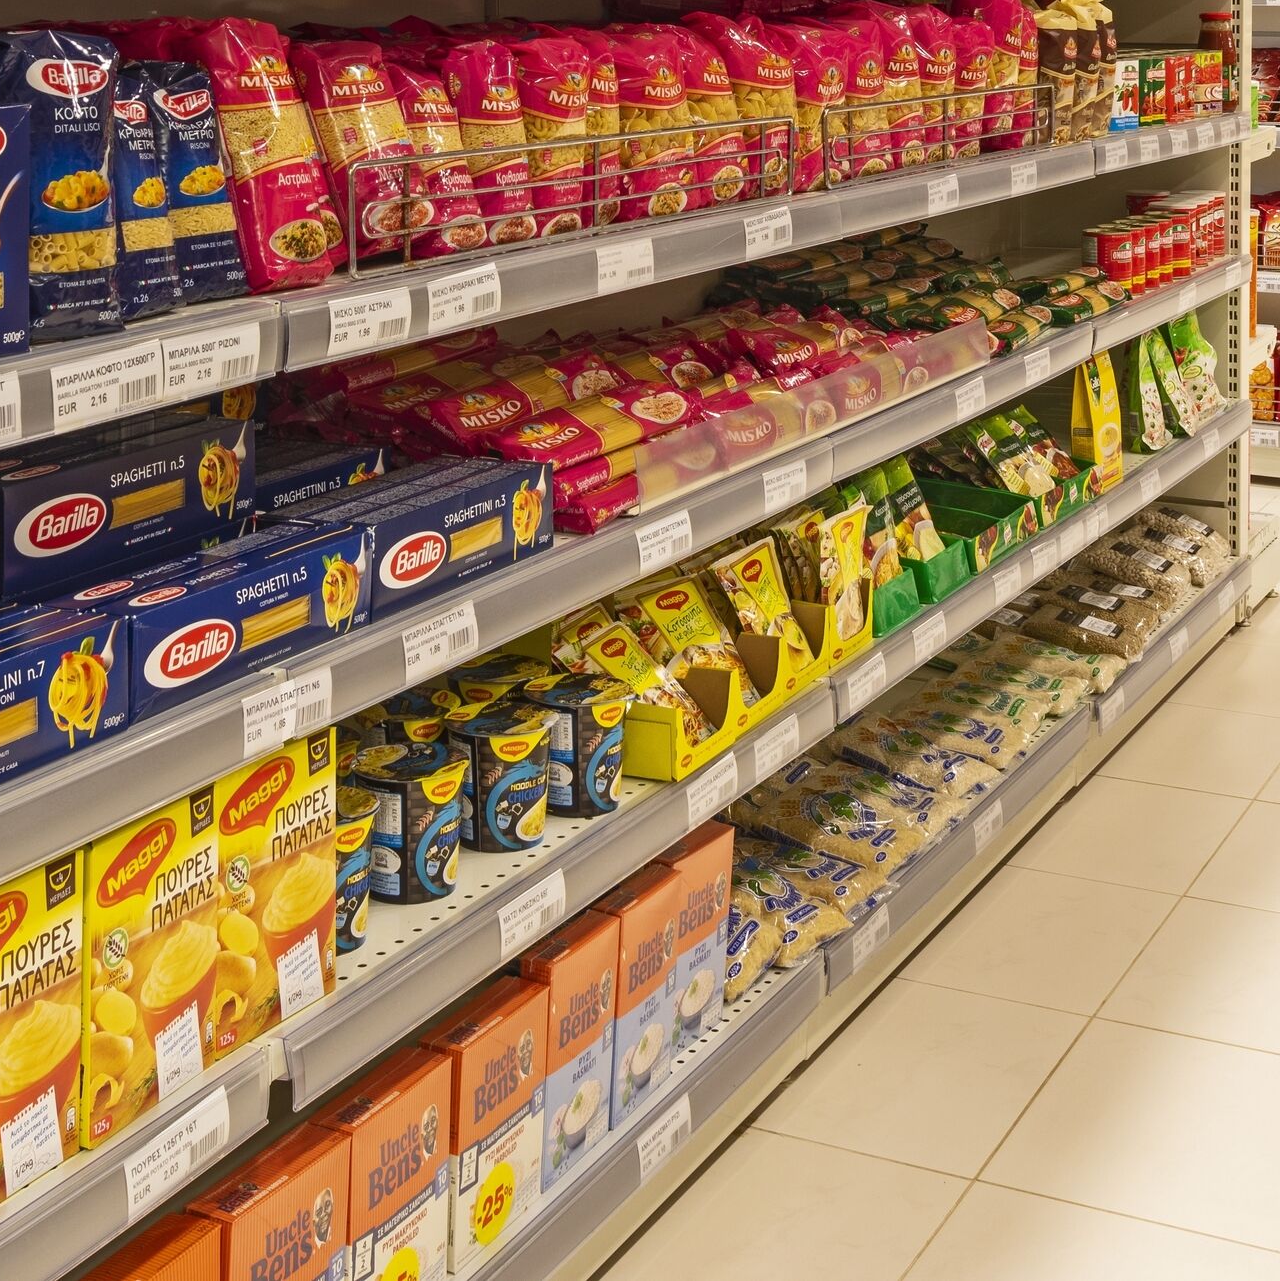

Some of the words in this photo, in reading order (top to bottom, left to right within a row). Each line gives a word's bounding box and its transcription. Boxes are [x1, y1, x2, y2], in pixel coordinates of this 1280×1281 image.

[332, 81, 384, 97] MISKO
[645, 84, 682, 98] MISKO
[460, 400, 522, 429] MISKO
[845, 389, 877, 409] MISKO
[110, 460, 167, 489] SPAGHETTI
[169, 455, 186, 474] n.5
[274, 484, 327, 508] SPAGHETTINI
[329, 476, 341, 490] n.3
[35, 500, 100, 543] Barilla
[444, 503, 491, 528] SPAGHETTINI
[494, 497, 506, 509] n.3
[395, 542, 441, 574] Barilla
[236, 575, 290, 605] SPAGHETTI
[293, 567, 307, 586] n.5
[659, 593, 689, 608] Maggi
[167, 627, 229, 671] Barilla
[27, 661, 45, 683] n.7
[502, 743, 527, 754] Maggi
[230, 762, 287, 826] Maggi
[275, 786, 329, 834] ΠΟΥΡΕΣ
[272, 811, 332, 861] ΠΑΤΑΤΑΣ
[106, 822, 169, 897] Maggi
[155, 847, 212, 900] ΠΟΥΡΕΣ
[152, 876, 215, 931] ΠΑΤΑΤΑΣ
[686, 885, 715, 914] Uncle
[1, 921, 73, 981] ΠΟΥΡΕΣ
[638, 931, 664, 965] Uncle
[568, 984, 603, 1022] Uncle
[483, 1049, 519, 1089] Uncle
[379, 1124, 421, 1166] Uncle
[477, 1184, 513, 1227] -25%
